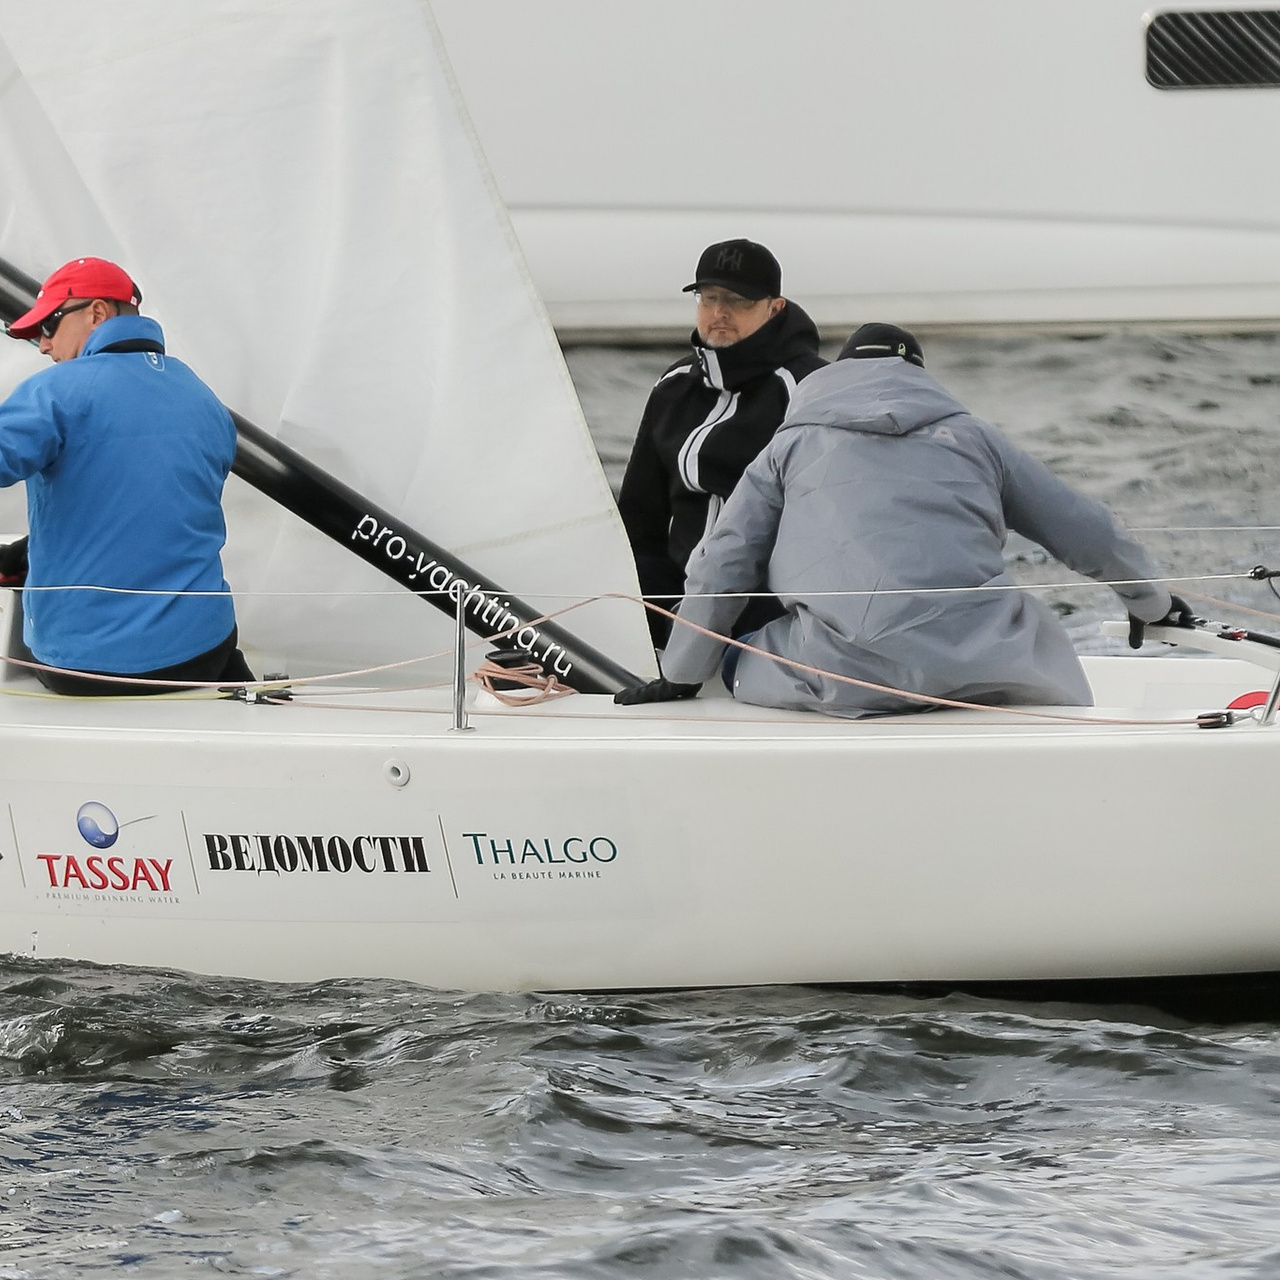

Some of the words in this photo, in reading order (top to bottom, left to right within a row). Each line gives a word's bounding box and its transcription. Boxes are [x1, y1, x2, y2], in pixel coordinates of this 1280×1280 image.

[202, 833, 432, 877] ВЕДОМОСТИ
[462, 832, 618, 865] THALGO
[36, 853, 173, 892] TASSAY
[493, 872, 506, 880] LA
[511, 871, 553, 880] BEAUTÉ
[558, 870, 602, 879] MARINE
[46, 892, 90, 901] PREMIUM
[95, 894, 144, 903] DRINKING
[148, 896, 181, 904] WATER
